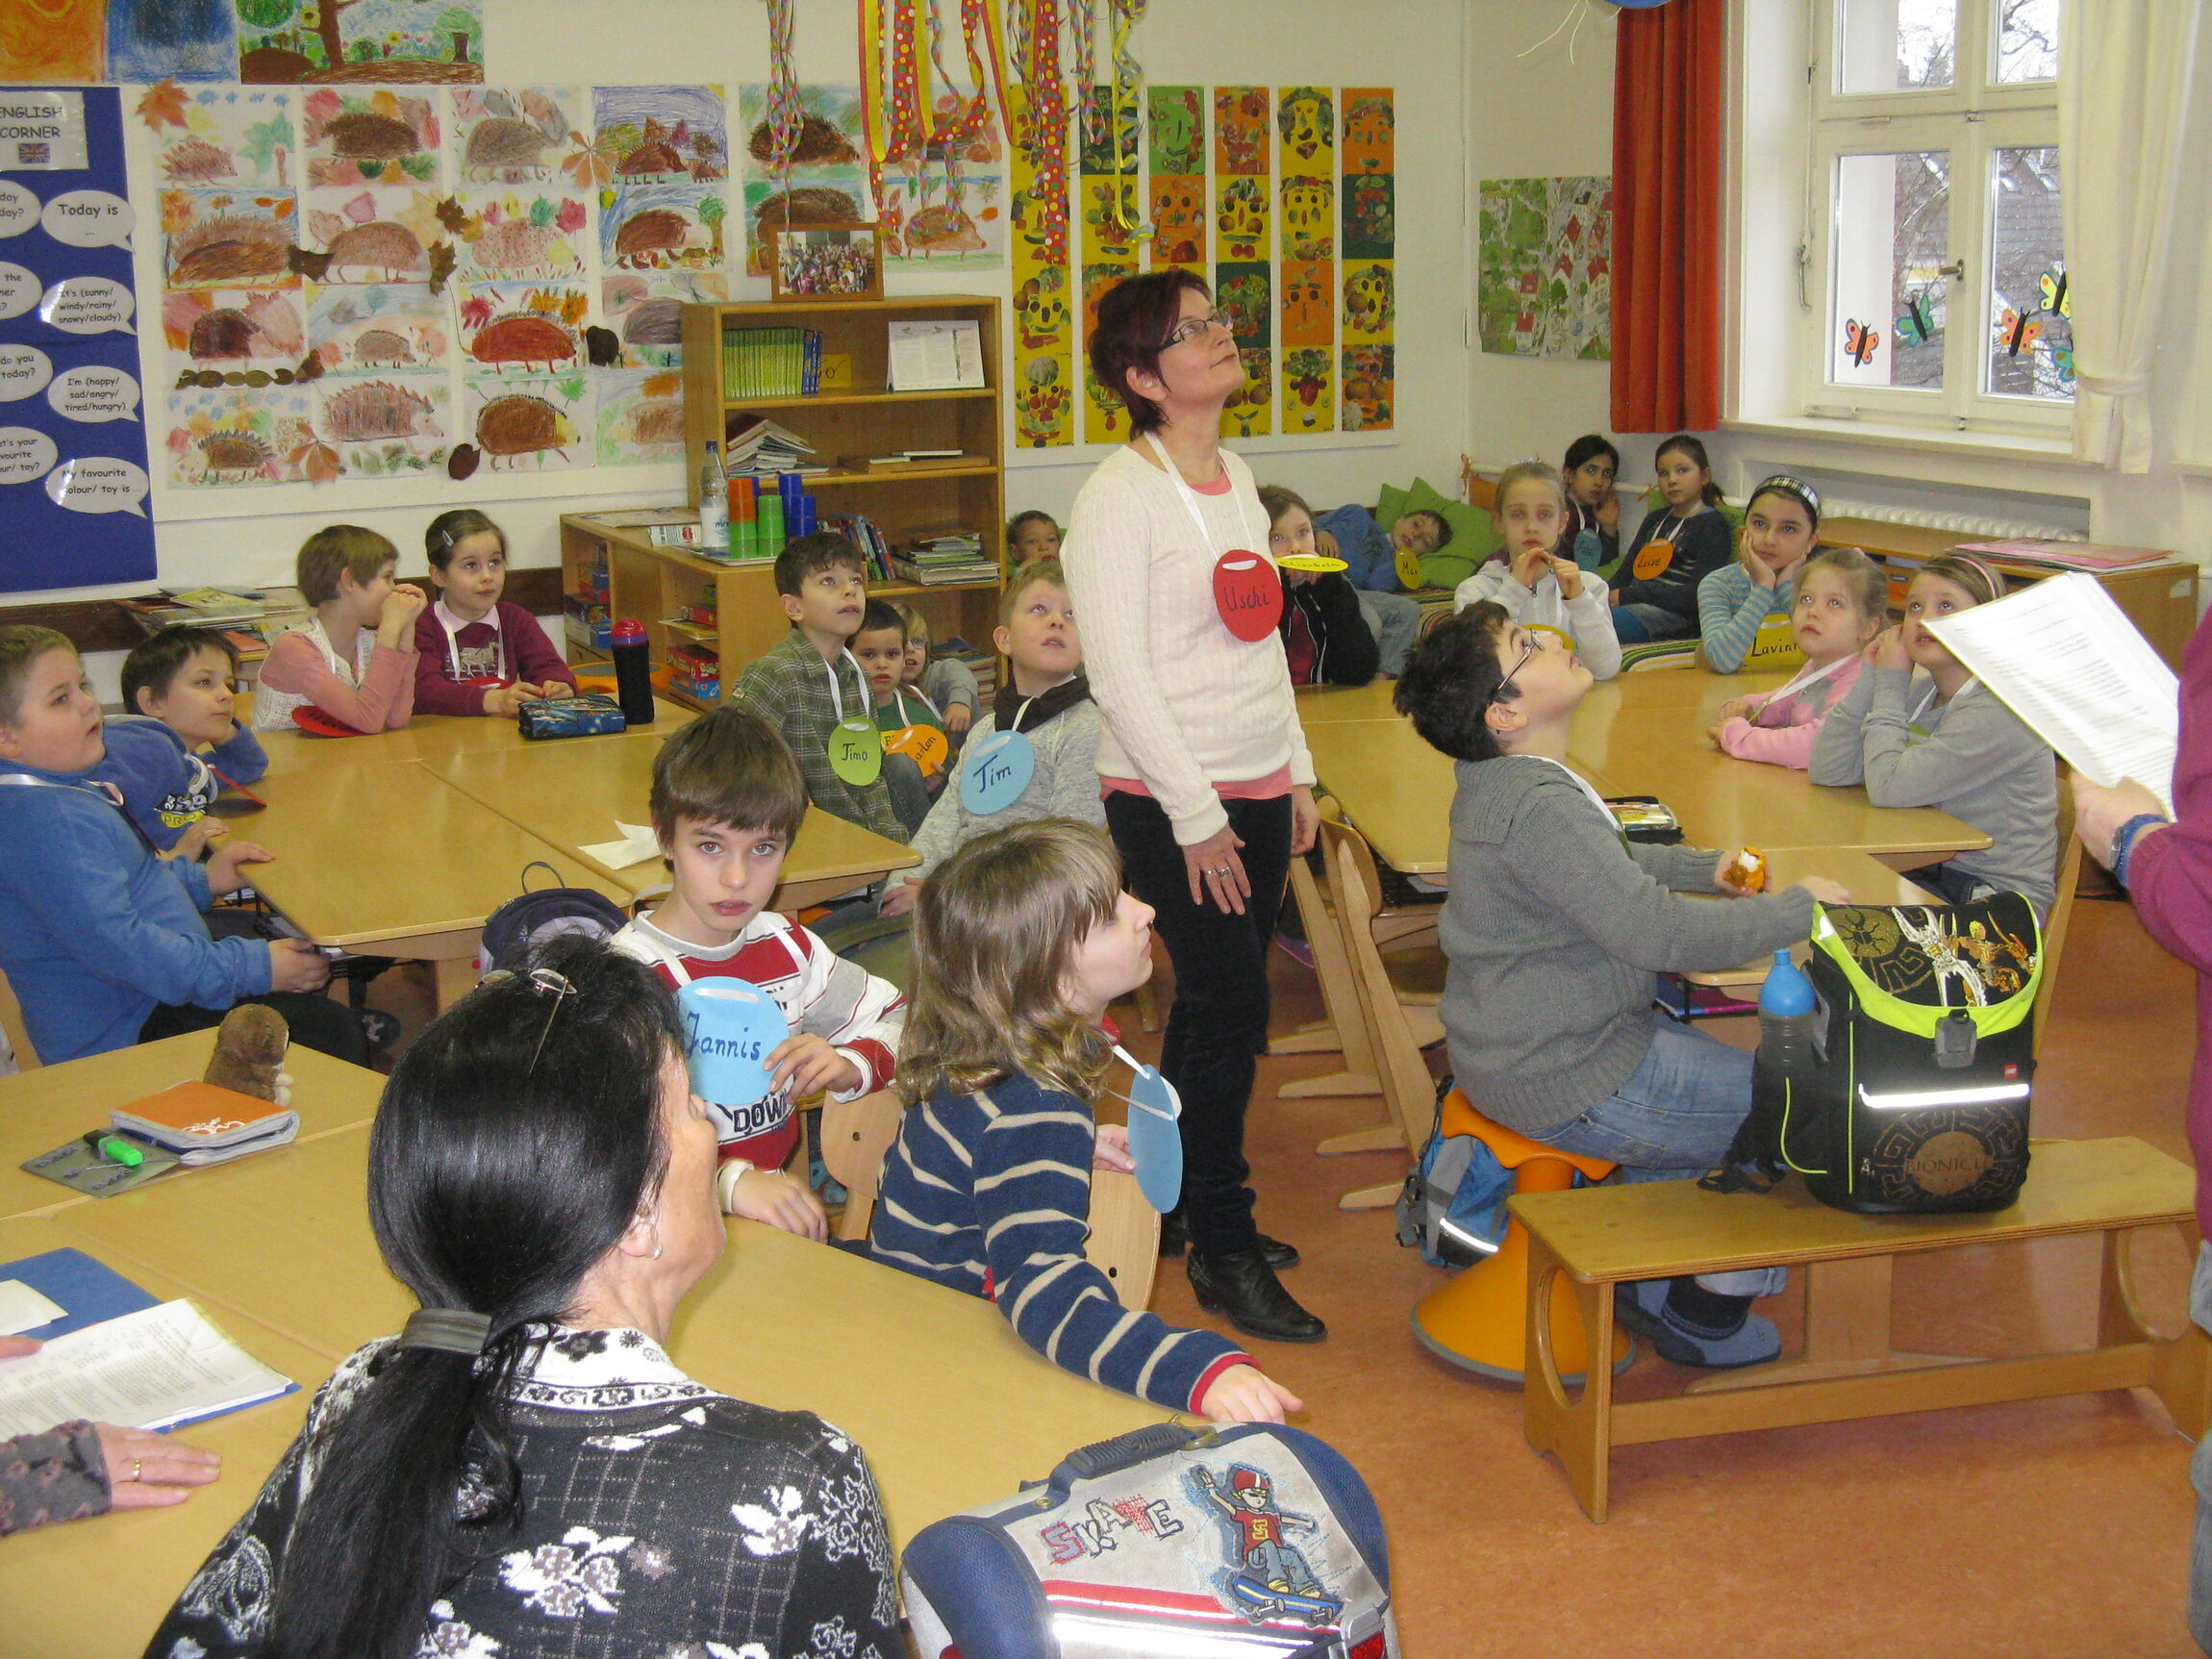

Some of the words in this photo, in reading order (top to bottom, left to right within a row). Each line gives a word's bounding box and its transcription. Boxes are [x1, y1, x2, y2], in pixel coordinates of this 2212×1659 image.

[0, 126, 61, 138] CORNER
[0, 208, 24, 219] day?
[58, 204, 101, 218] Today
[107, 204, 118, 215] is
[5, 273, 22, 282] the
[16, 356, 34, 365] you
[1, 367, 36, 379] today?
[69, 390, 119, 400] sad/angry/
[17, 439, 38, 448] your
[0, 465, 15, 473] our/
[20, 463, 39, 472] toy?
[82, 468, 127, 478] favourite
[64, 484, 97, 494] olour/
[103, 484, 117, 494] toy
[122, 484, 131, 493] is
[1223, 585, 1269, 611] Uschi
[1751, 637, 1799, 657] Lavini
[973, 754, 1012, 793] Tim
[687, 1011, 762, 1061] Jannis
[1041, 1494, 1184, 1566] SKATE
